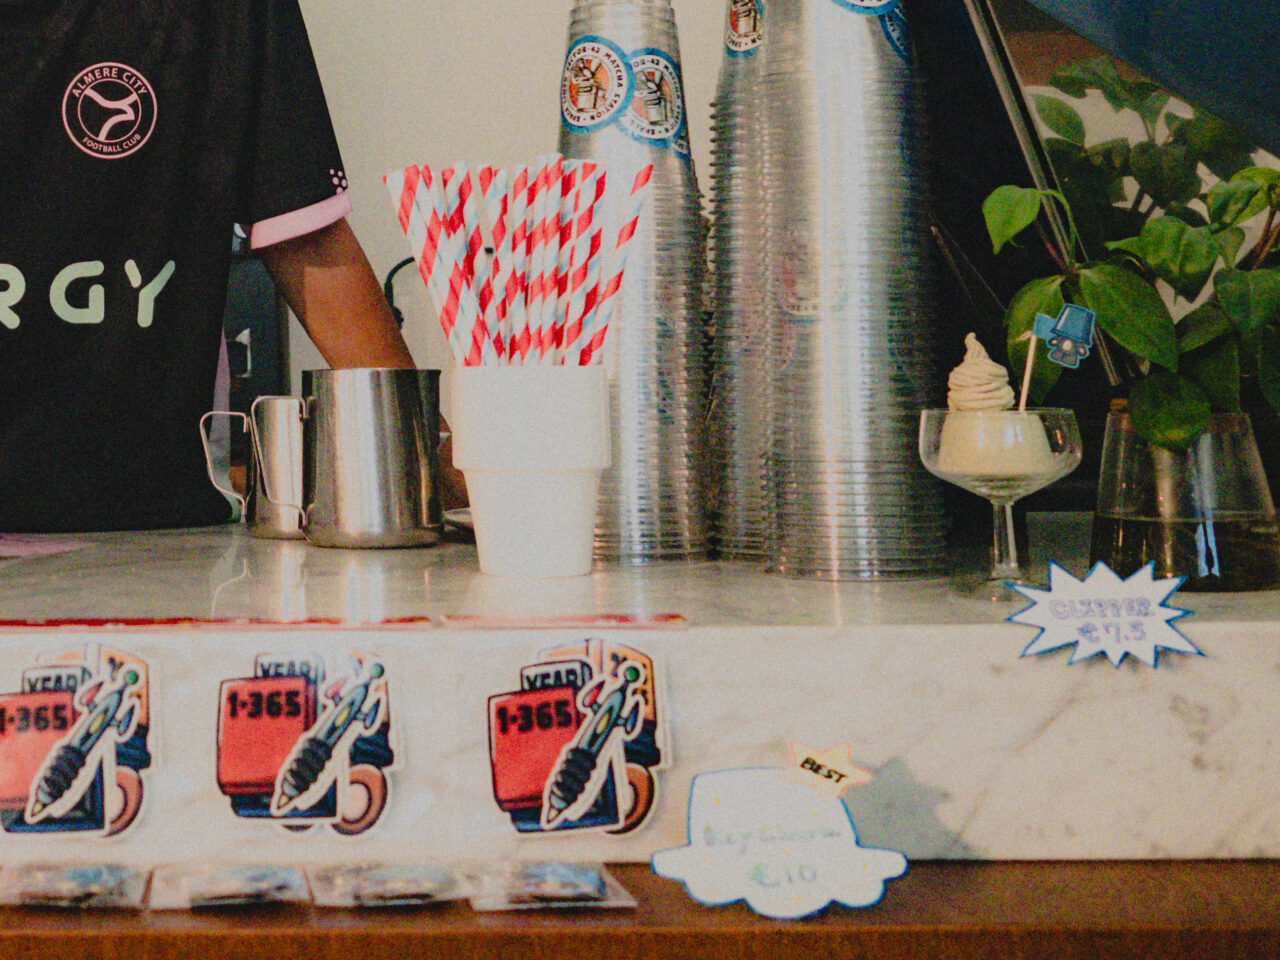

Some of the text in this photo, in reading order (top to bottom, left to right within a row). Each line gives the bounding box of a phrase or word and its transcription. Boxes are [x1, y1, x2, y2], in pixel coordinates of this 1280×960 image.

[72, 67, 148, 98] ALMERE CITY
[82, 133, 142, 153] FOOTBALL CLUB
[800, 756, 848, 783] BEST
